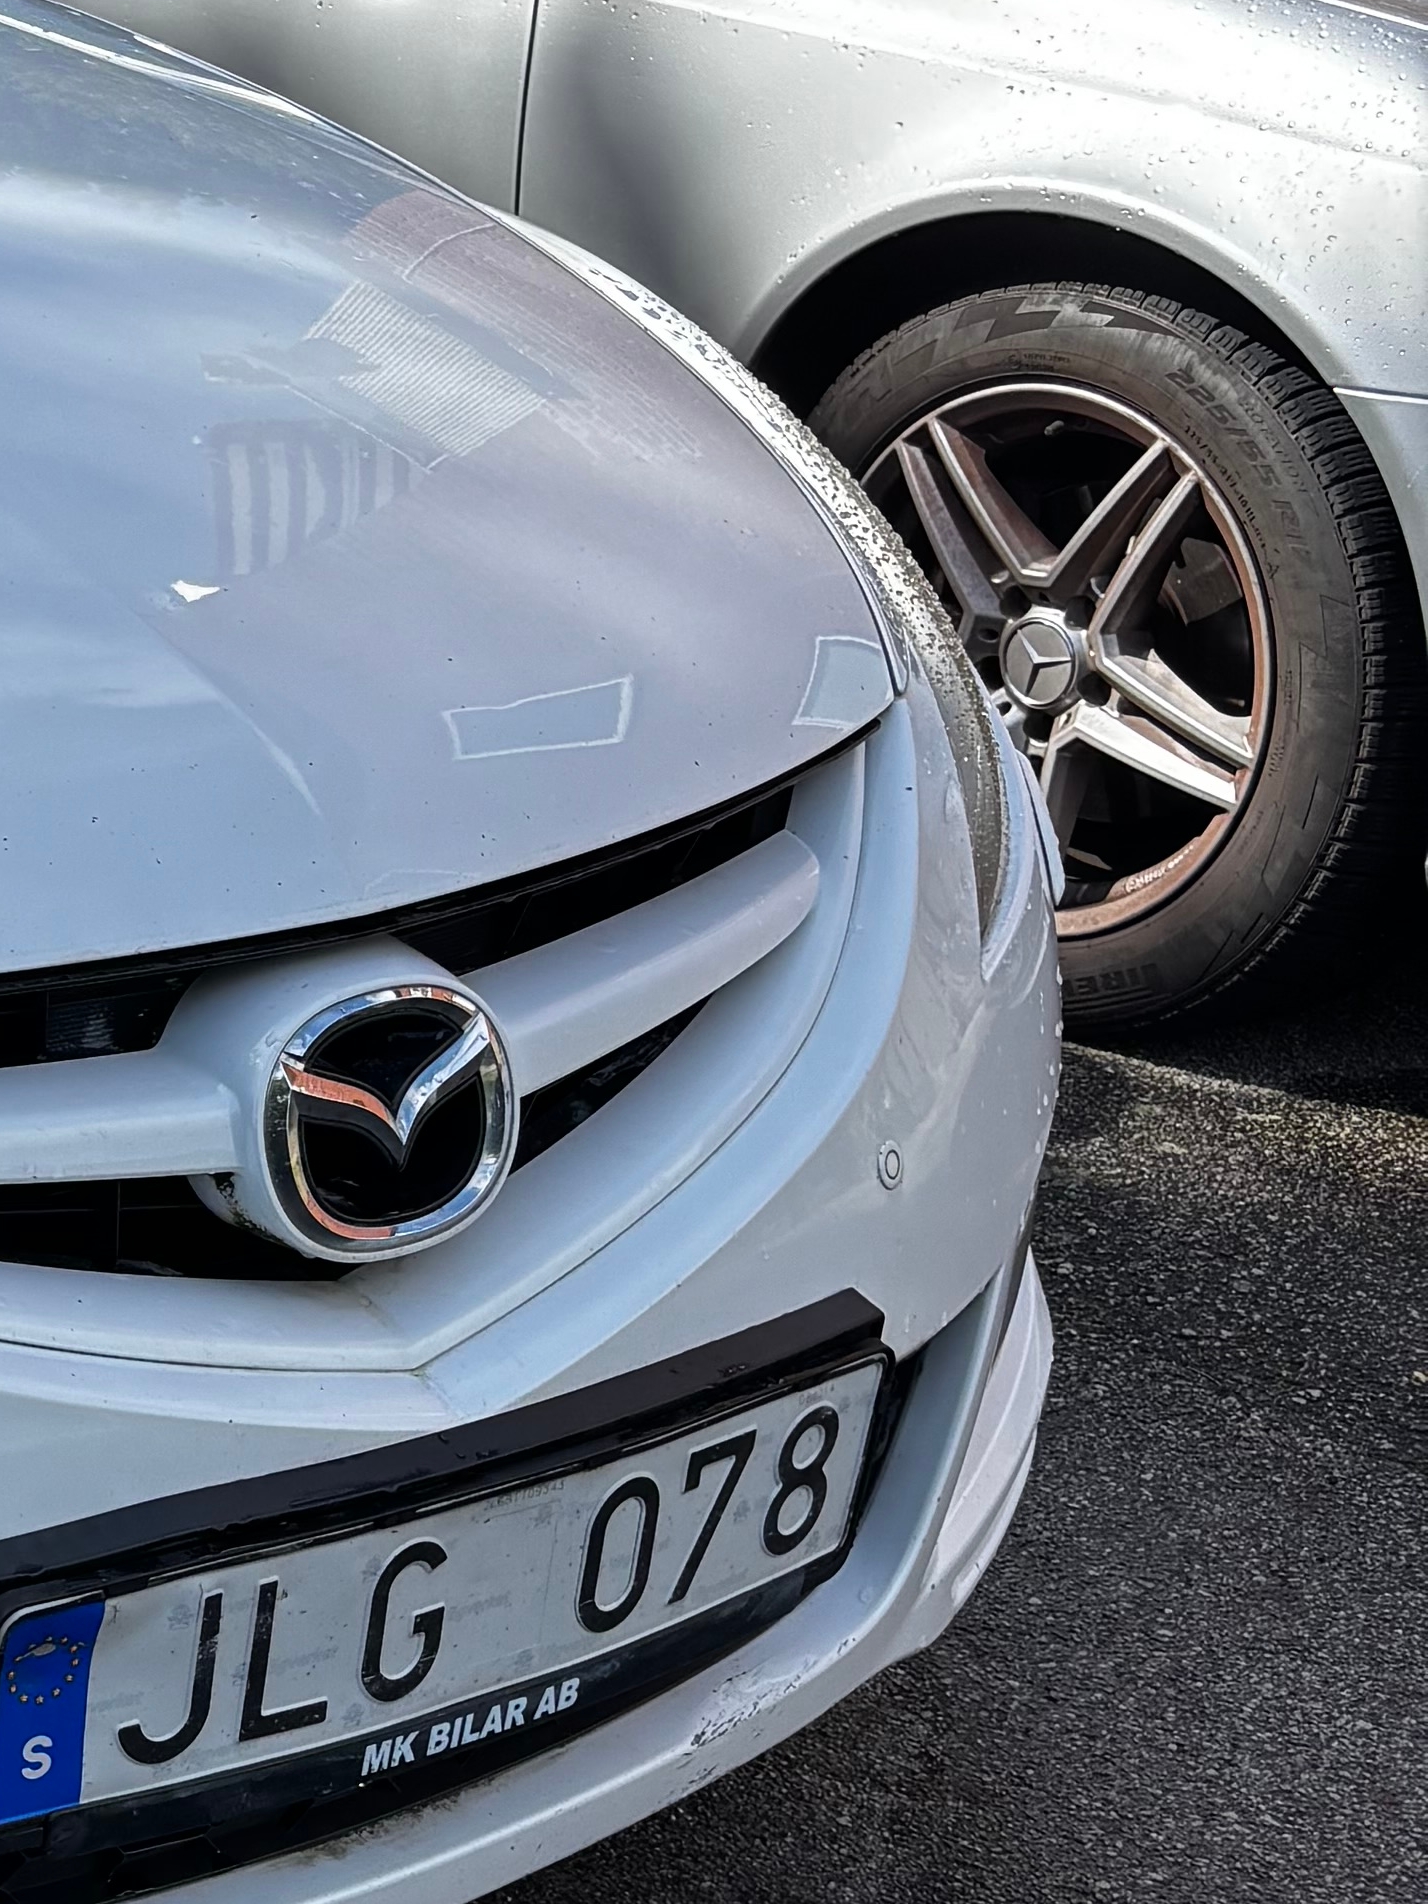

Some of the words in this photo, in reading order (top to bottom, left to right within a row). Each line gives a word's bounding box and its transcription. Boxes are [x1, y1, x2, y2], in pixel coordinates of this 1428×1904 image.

[1165, 368, 1282, 486] 225/55
[117, 1540, 448, 1765] JLG
[576, 1404, 840, 1634] 078
[21, 1734, 54, 1781] S
[360, 1730, 420, 1777] MK
[426, 1696, 528, 1757] BILAR
[532, 1677, 581, 1721] AB
